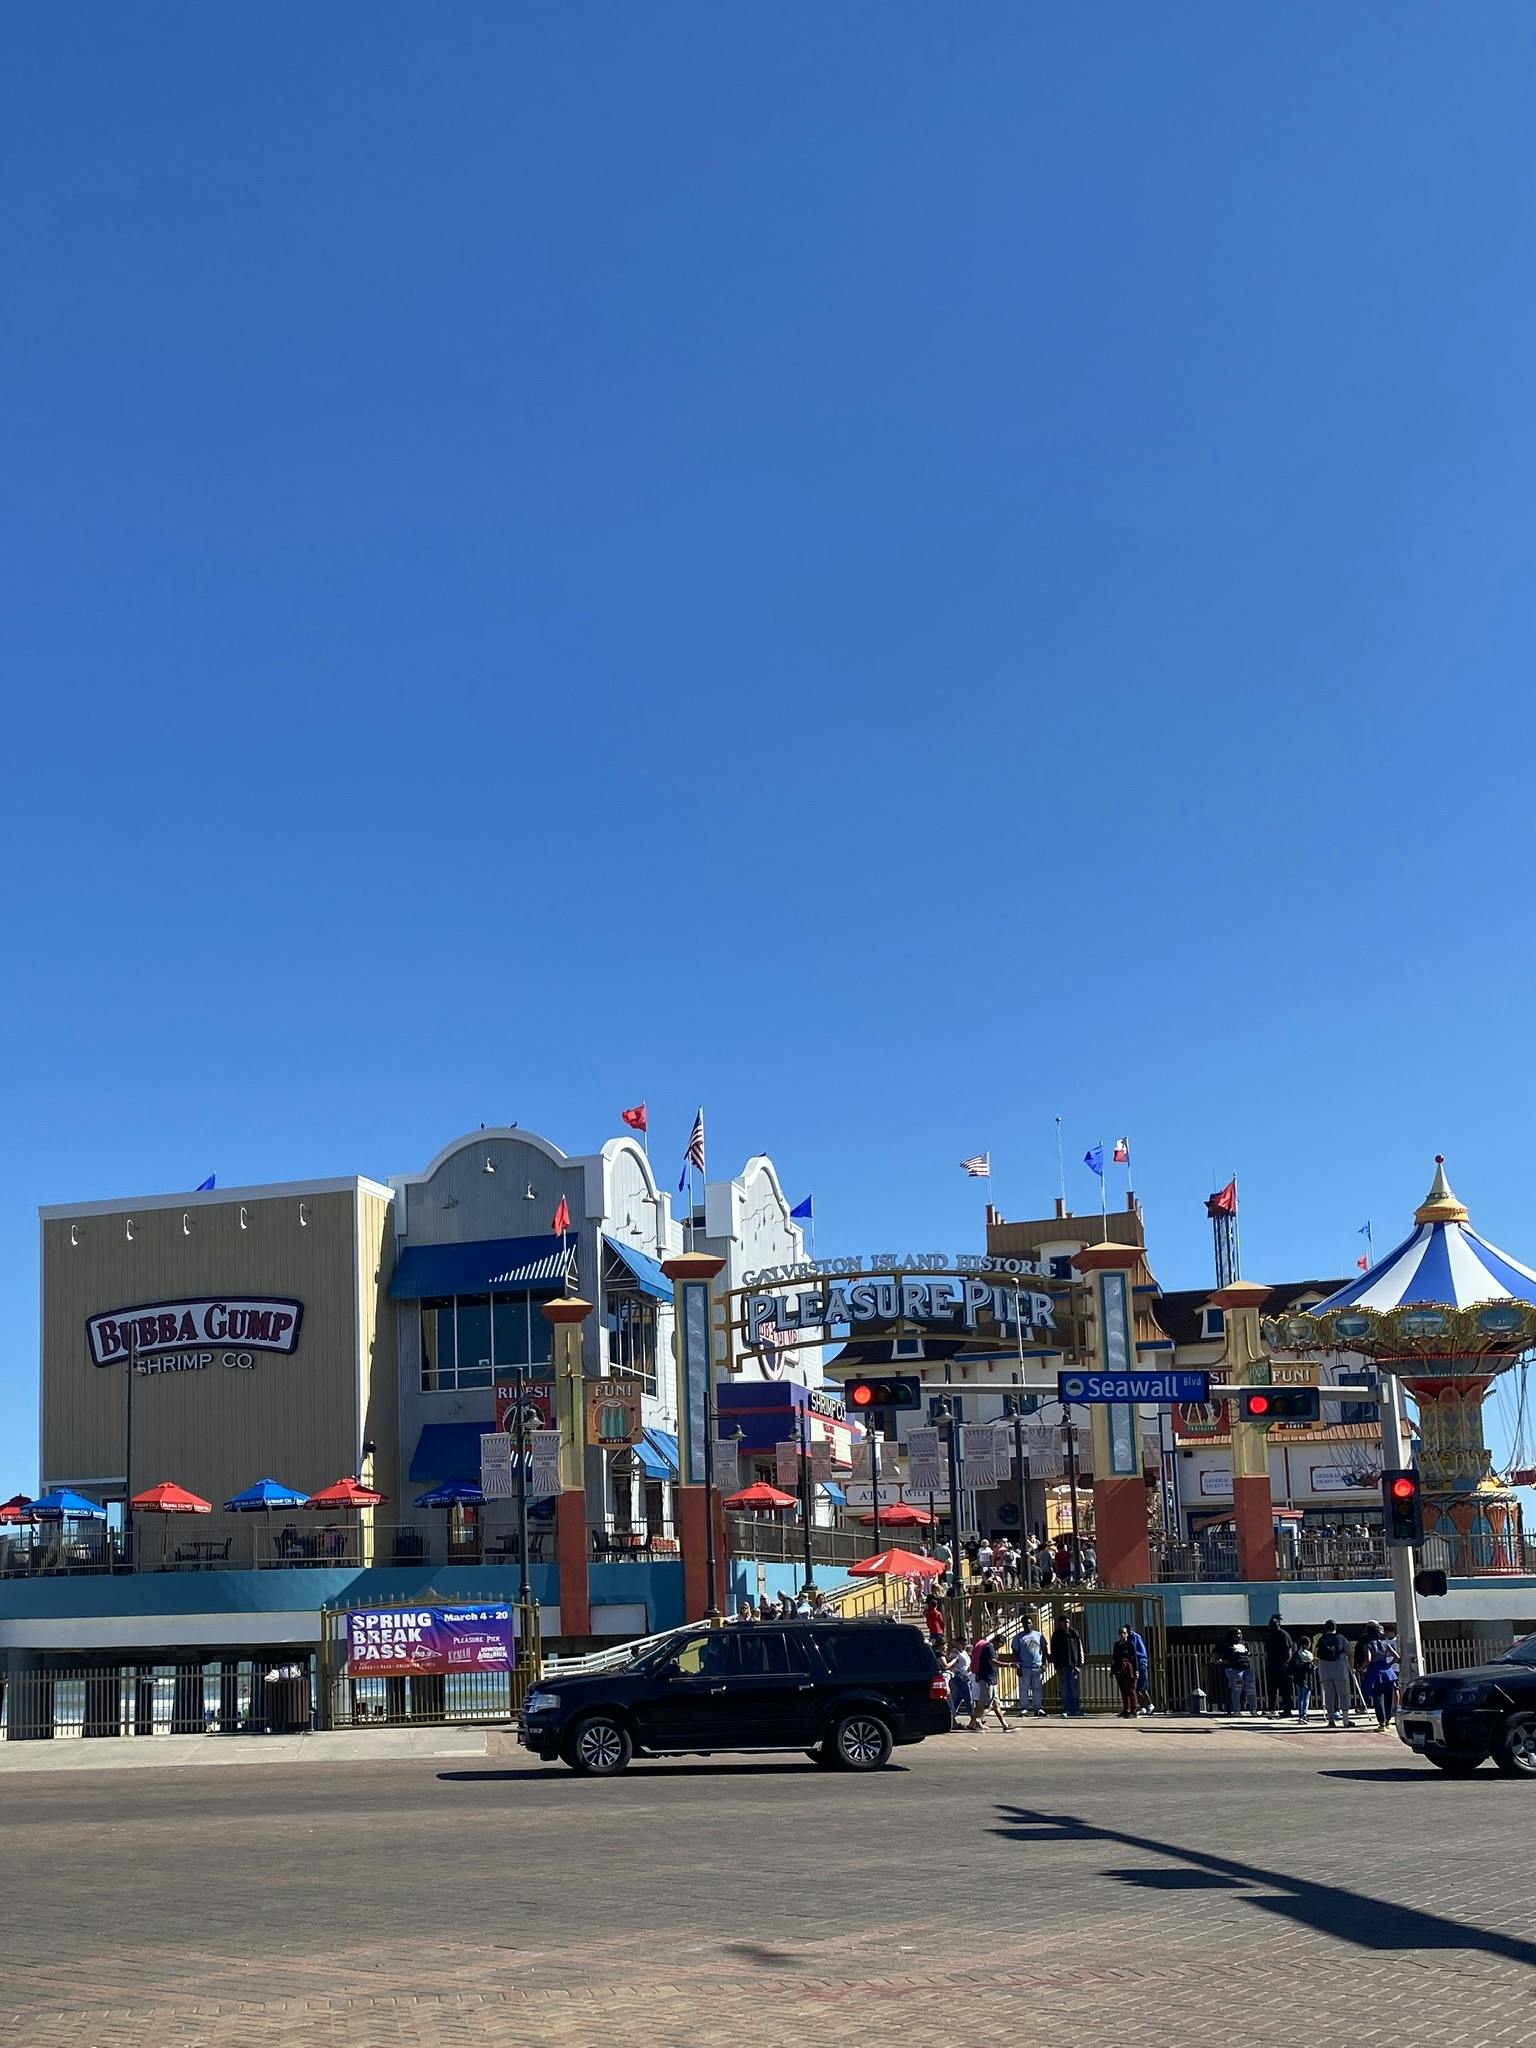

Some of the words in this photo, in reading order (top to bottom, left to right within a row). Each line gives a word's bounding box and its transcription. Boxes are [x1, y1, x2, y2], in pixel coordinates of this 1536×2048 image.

[741, 1255, 863, 1286] GALVESTON
[871, 1253, 949, 1271] ISLAND
[955, 1254, 1057, 1279] HISTORIC
[745, 1282, 954, 1345] PLEASURE
[959, 1279, 1058, 1329] PIER
[96, 1309, 199, 1357] BUBBA
[203, 1303, 294, 1342] GUMP
[138, 1353, 213, 1375] SHRIMP
[1272, 1369, 1311, 1382] FUN!
[498, 1386, 548, 1399] RIES!
[594, 1384, 632, 1397] FUN!
[1088, 1375, 1179, 1398] Seawall
[1183, 1376, 1201, 1387] Blvd
[811, 1392, 837, 1419] SHRIMP
[352, 1612, 432, 1630] SPRING
[443, 1613, 477, 1622] March
[495, 1611, 508, 1620] 20
[353, 1628, 423, 1646] BREAK
[453, 1636, 483, 1645] PLEASURE
[353, 1644, 407, 1661] PASS
[477, 1651, 508, 1660] AQUARIUM
